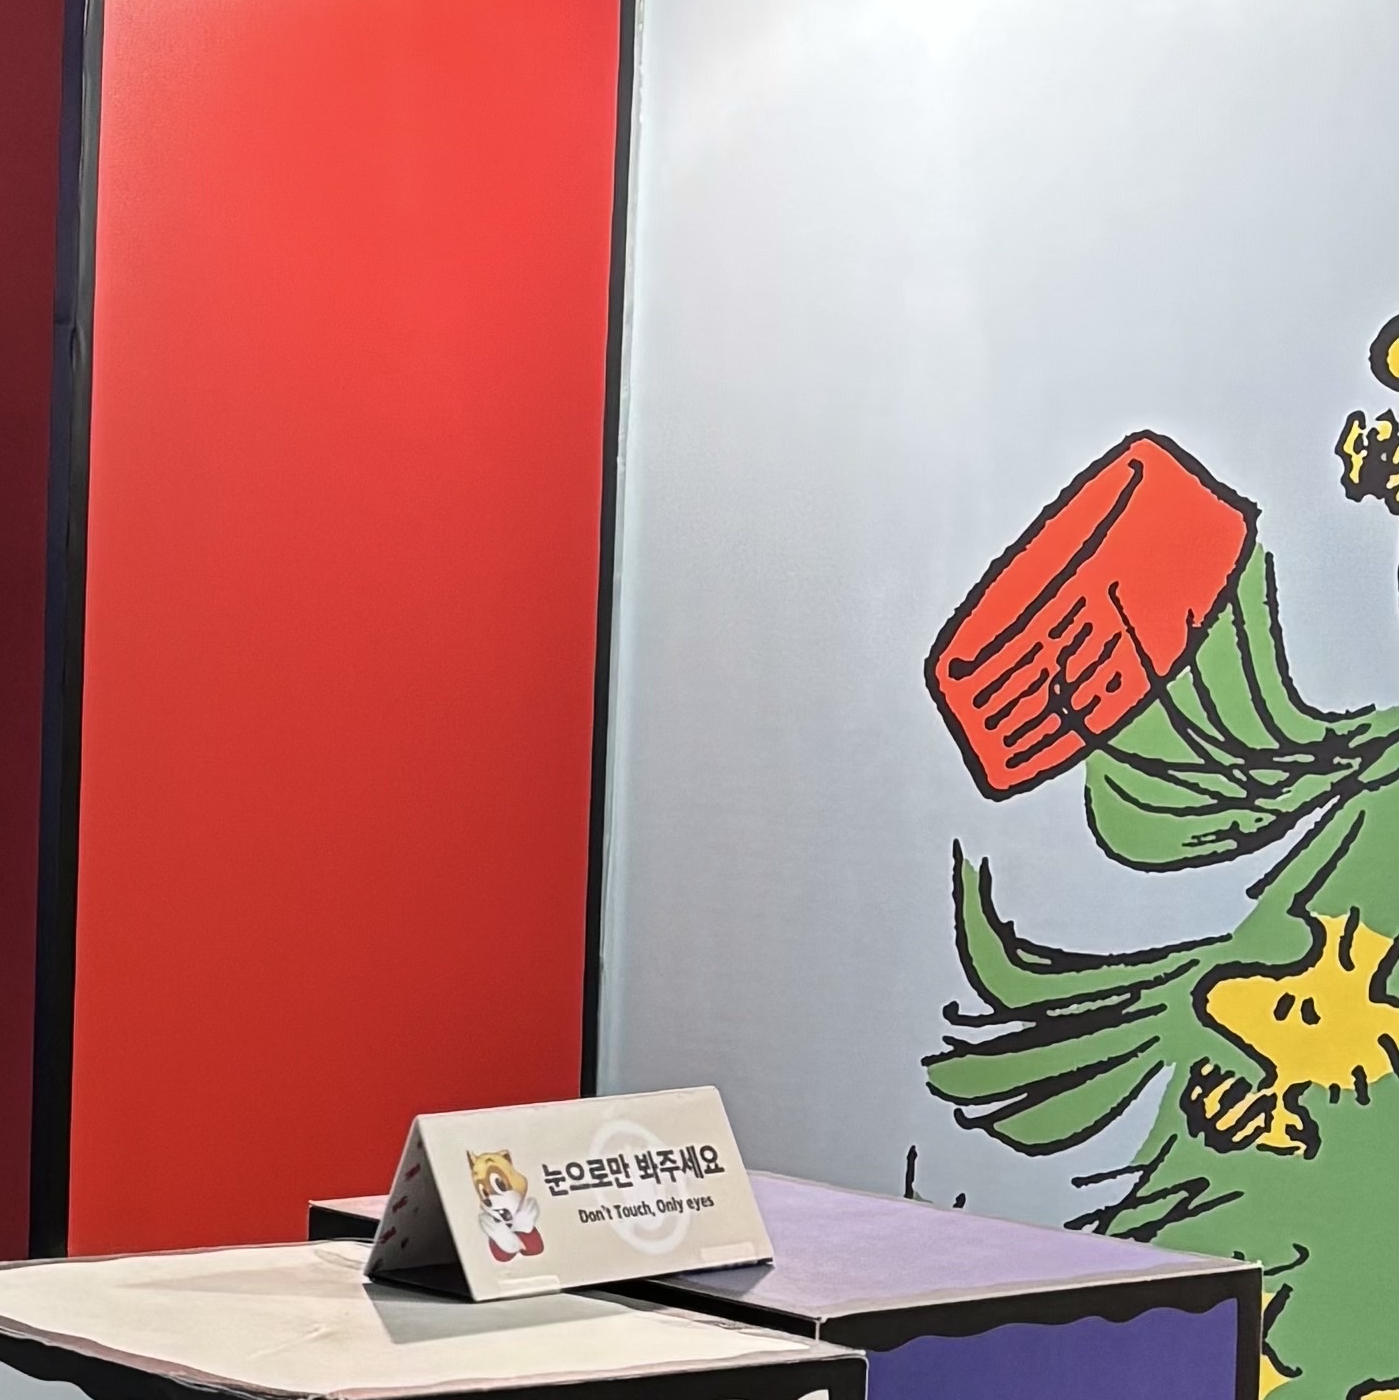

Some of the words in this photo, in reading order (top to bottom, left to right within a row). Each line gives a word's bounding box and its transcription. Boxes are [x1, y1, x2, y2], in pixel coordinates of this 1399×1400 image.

[541, 1153, 634, 1197] 눈으로만
[635, 1144, 726, 1185] 봐주세요
[578, 1203, 614, 1224] Don't
[615, 1199, 656, 1221] Touch,
[655, 1197, 684, 1217] Only
[686, 1194, 715, 1211] eyes
